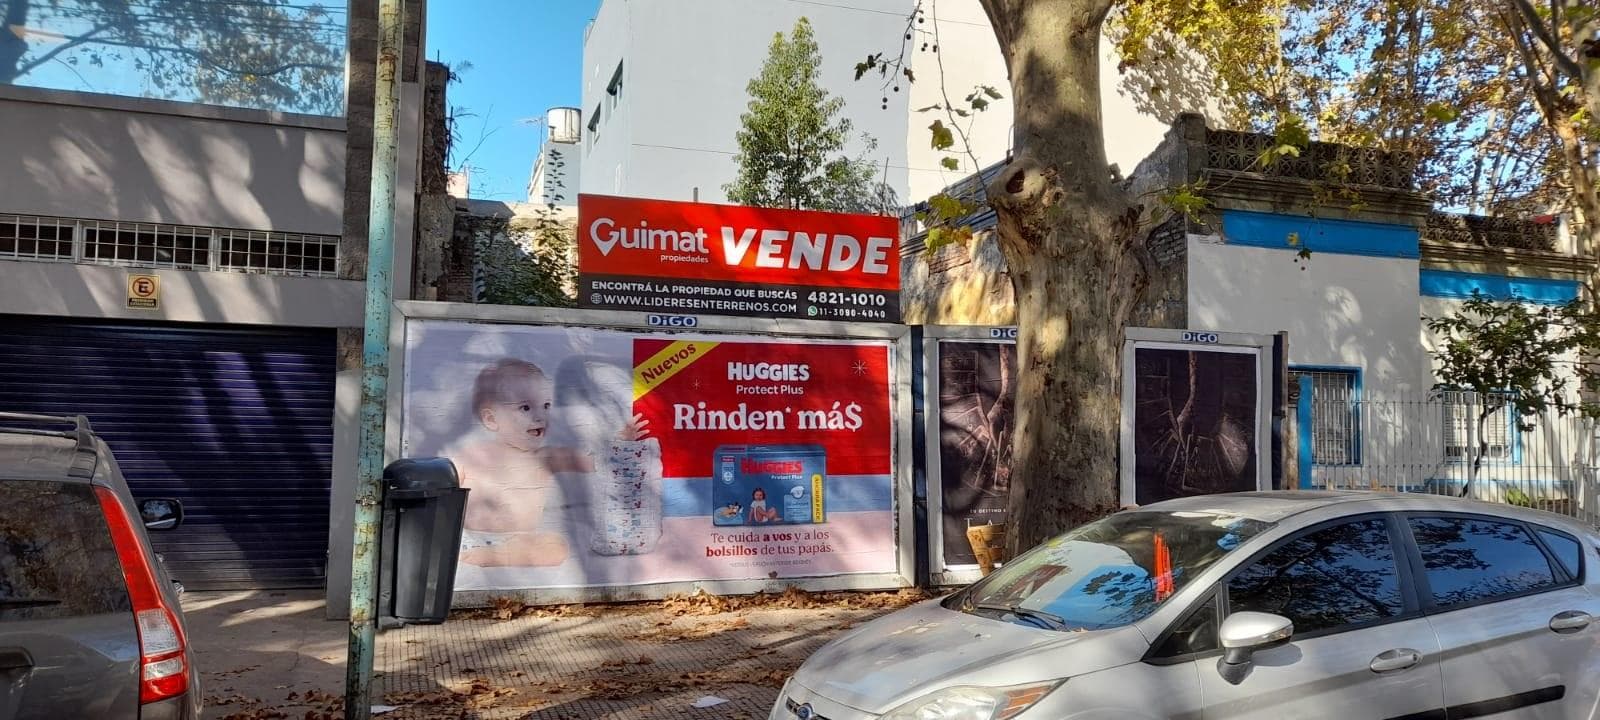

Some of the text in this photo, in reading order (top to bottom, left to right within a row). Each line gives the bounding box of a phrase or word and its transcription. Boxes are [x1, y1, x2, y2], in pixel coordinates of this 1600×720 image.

[590, 217, 893, 274] Guimat VENDE
[660, 254, 709, 263] propiedades
[591, 280, 886, 306] ENCONTRÁ LA PROPIEDAD QUE BUSCÁS 4821-1010
[603, 294, 797, 313] WWW.LIDERESENTERRENOS.COM
[990, 327, 1017, 338] DiG
[641, 342, 697, 384] Nuevos
[727, 362, 810, 382] HUGGIES
[736, 385, 804, 396] Protect Plus
[797, 401, 863, 432] má$
[711, 533, 725, 543] Te
[727, 532, 760, 543] cuida
[773, 533, 792, 541] vos
[794, 533, 801, 543] y
[813, 529, 830, 540] los
[706, 542, 834, 557] bolsillos de tus papás.
